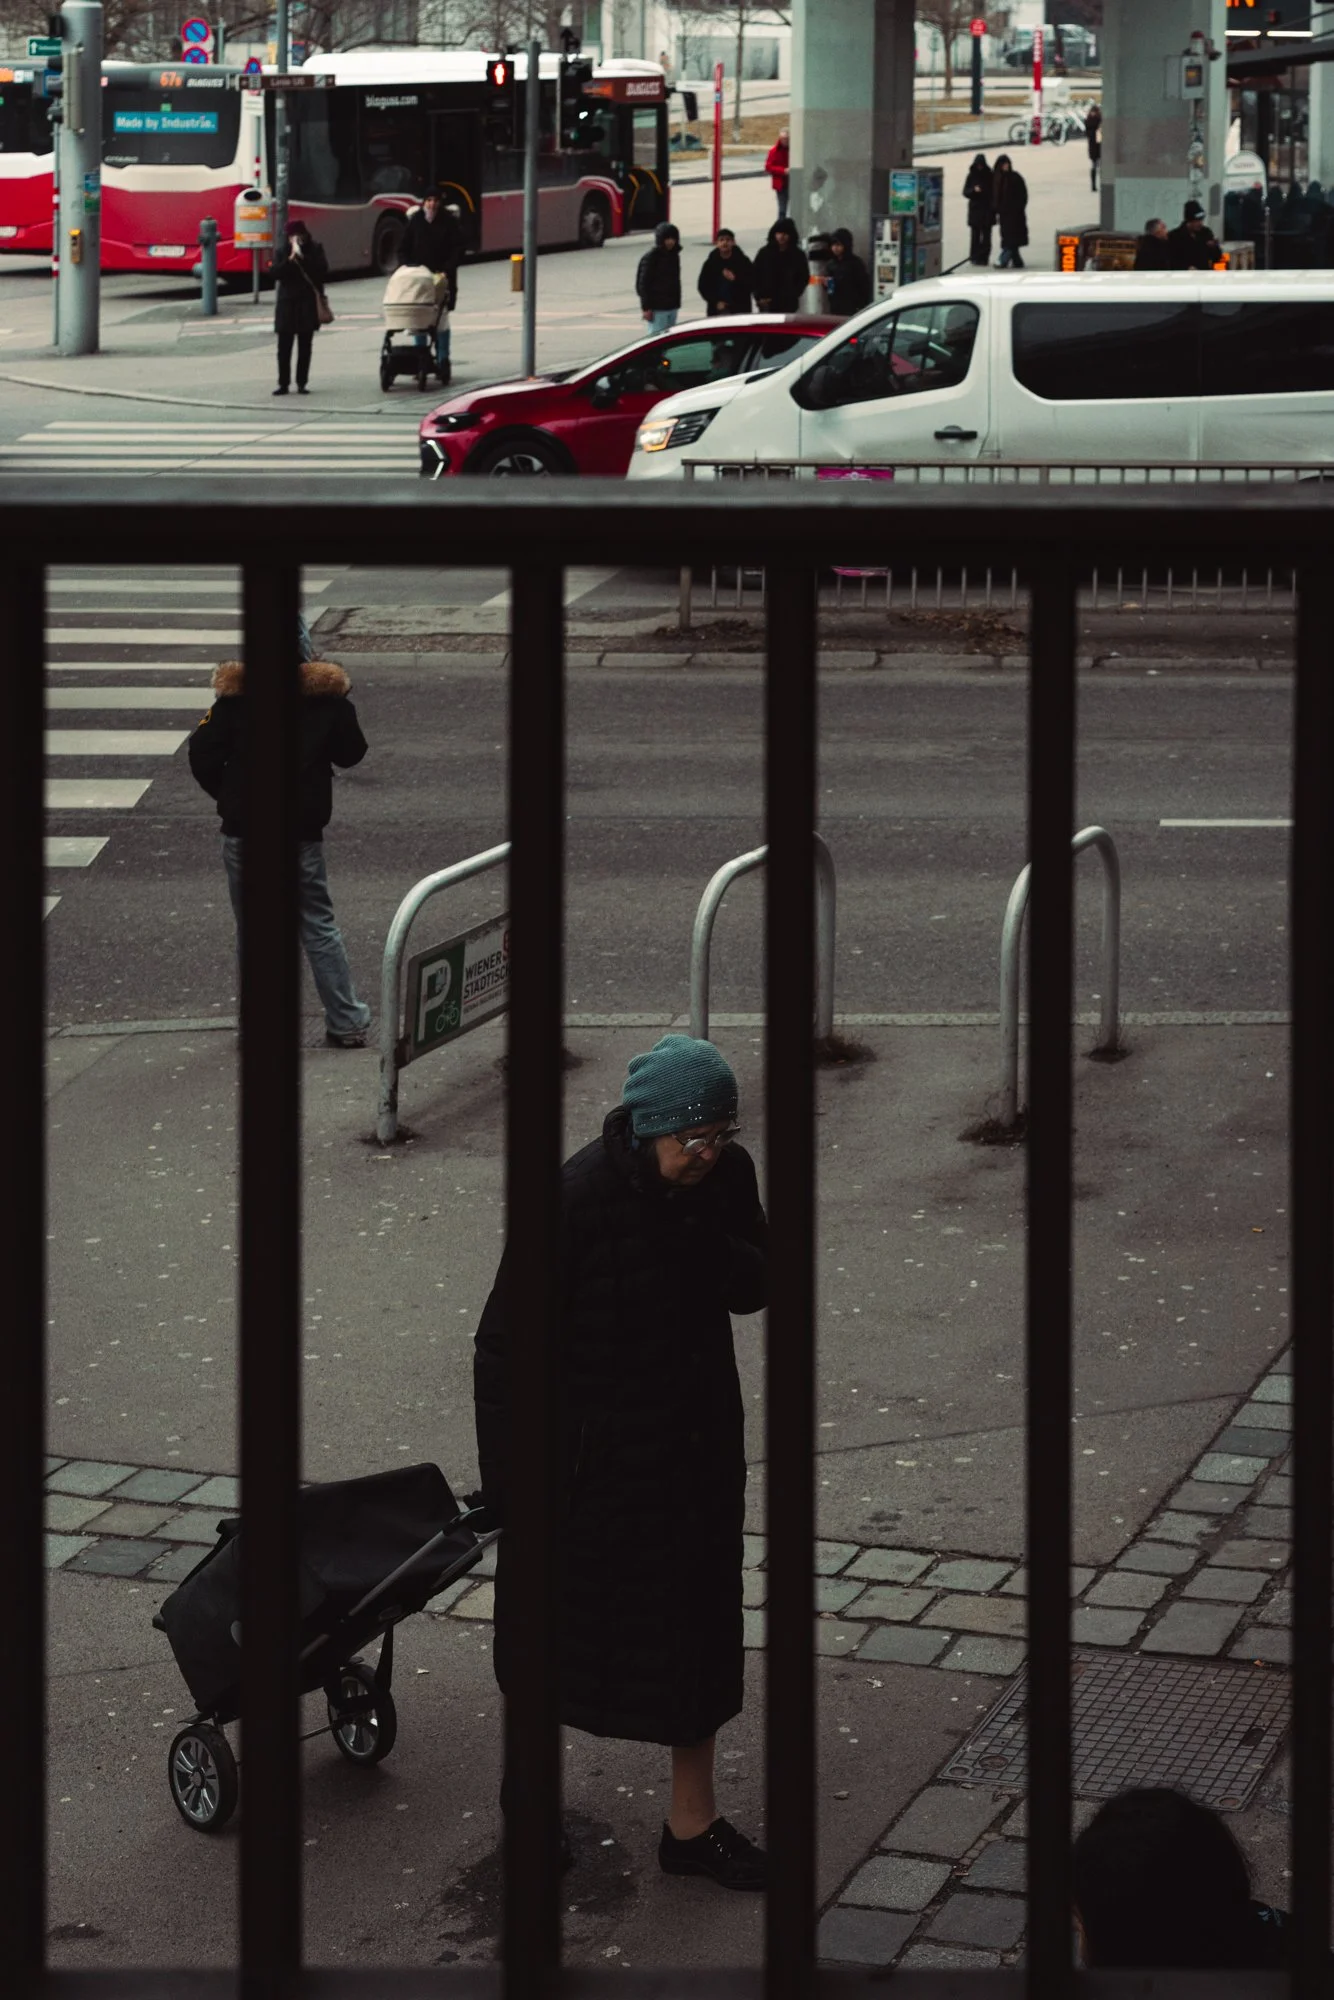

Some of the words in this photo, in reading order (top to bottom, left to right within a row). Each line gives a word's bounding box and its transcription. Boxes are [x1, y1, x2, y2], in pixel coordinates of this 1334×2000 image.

[364, 95, 419, 110] blaguss.com
[115, 117, 143, 128] Made
[146, 117, 159, 131] by
[466, 950, 502, 980] WIENER
[418, 958, 452, 1042] P
